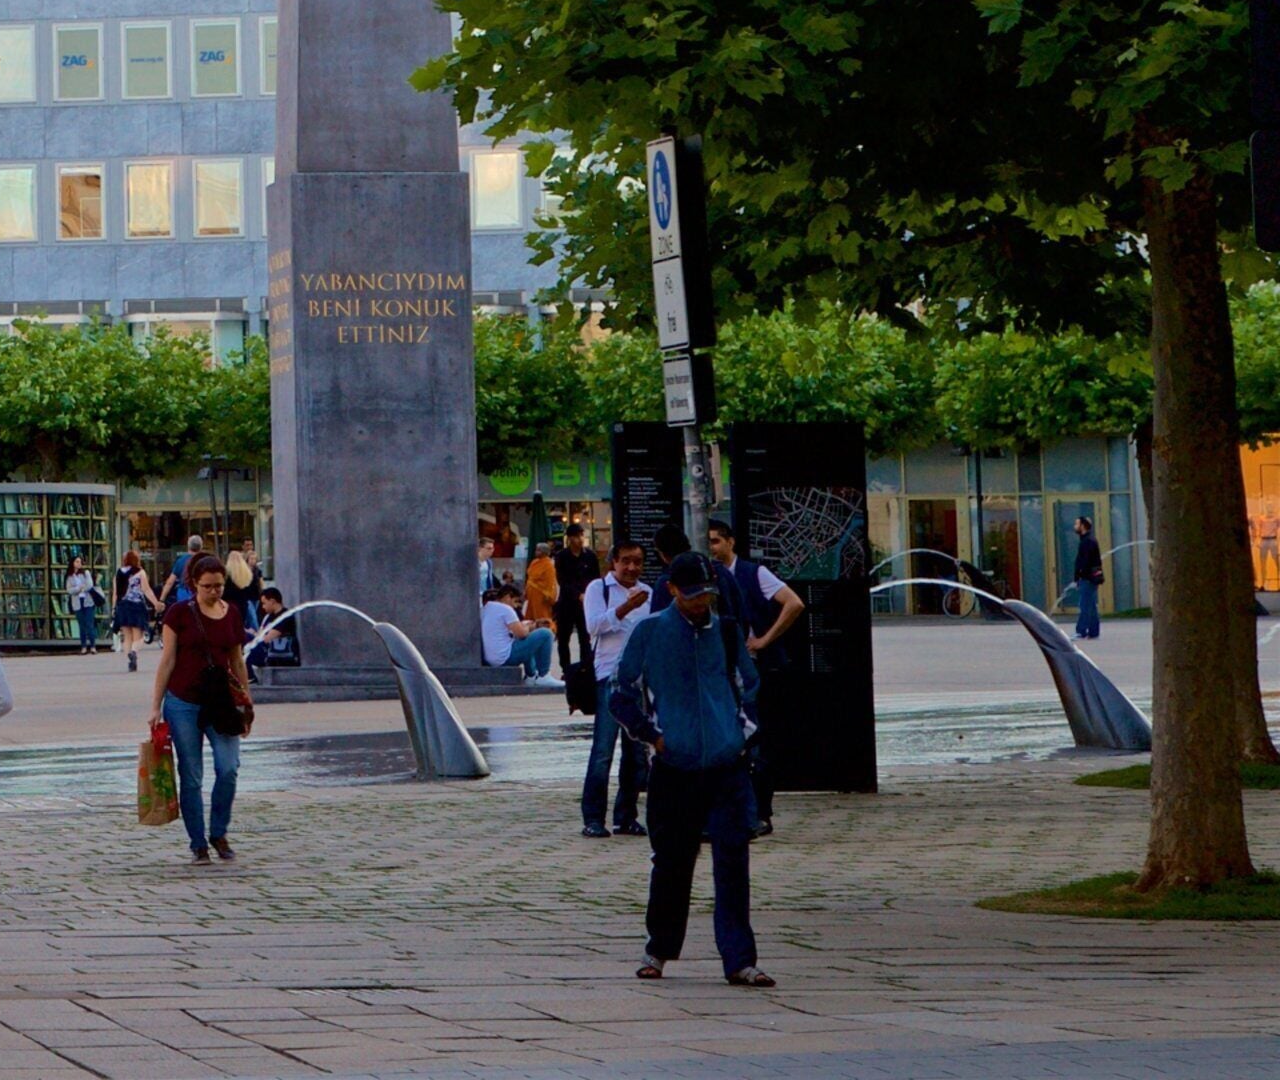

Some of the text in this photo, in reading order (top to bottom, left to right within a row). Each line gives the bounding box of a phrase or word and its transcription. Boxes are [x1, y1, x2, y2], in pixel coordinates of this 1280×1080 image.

[62, 55, 88, 67] ZAG
[199, 50, 225, 63] ZAG
[371, 299, 456, 318] KONUK
